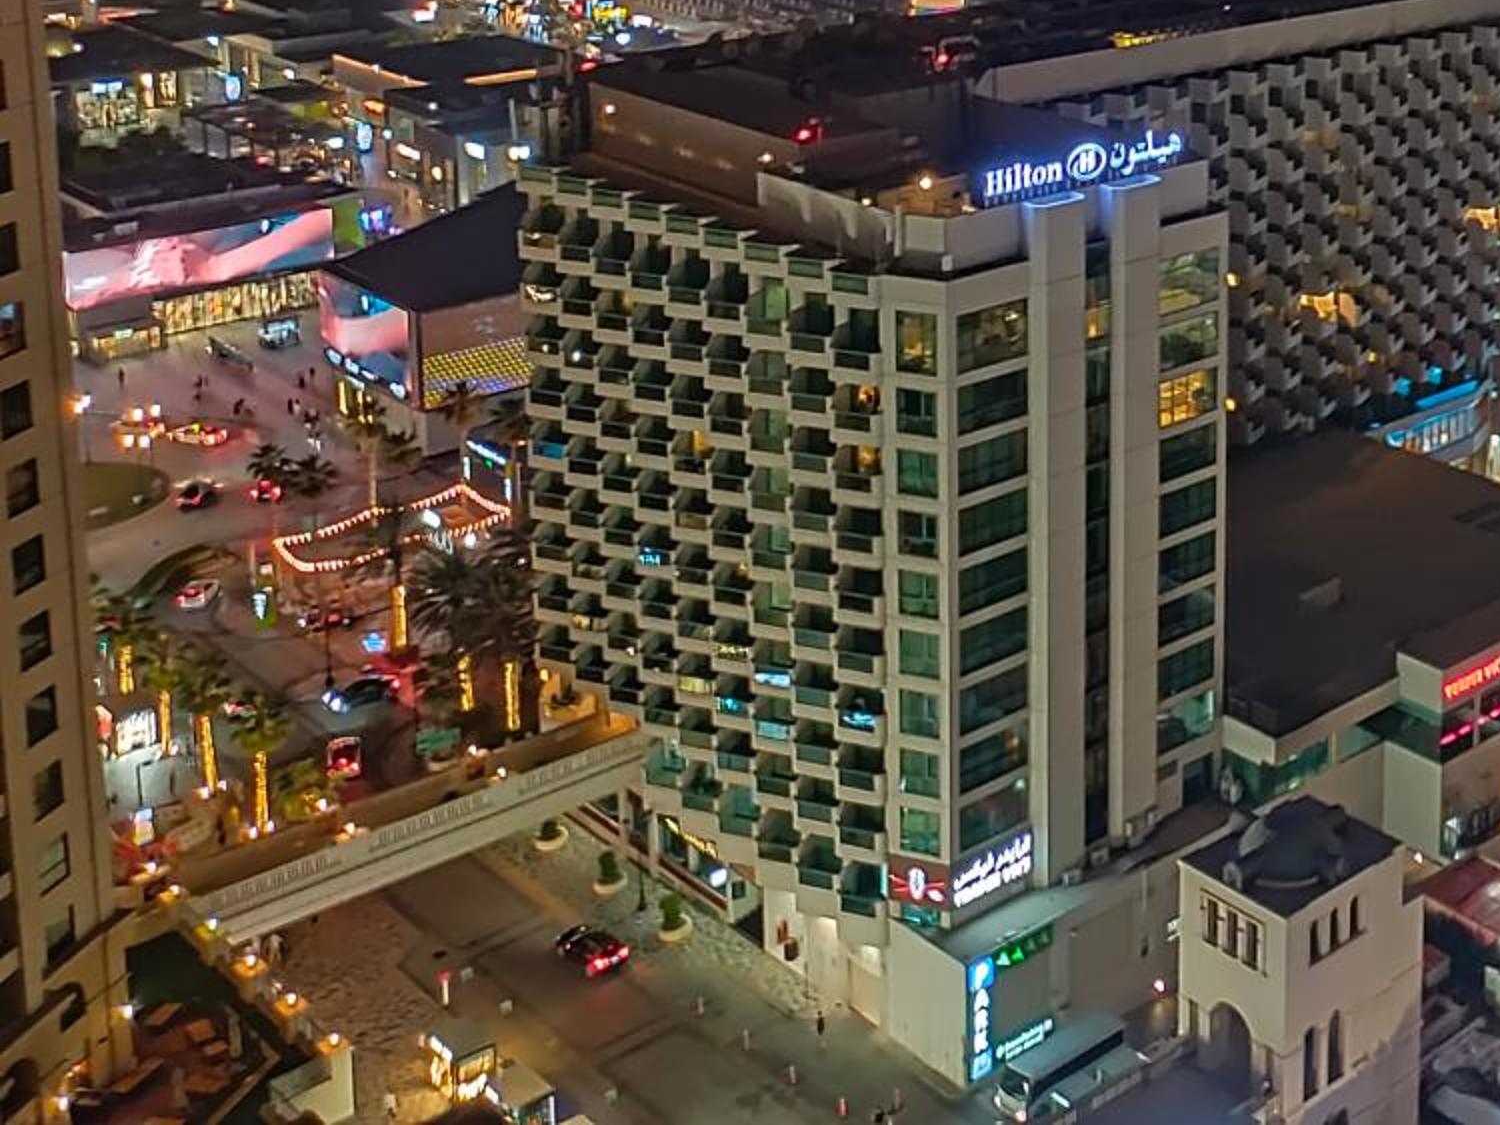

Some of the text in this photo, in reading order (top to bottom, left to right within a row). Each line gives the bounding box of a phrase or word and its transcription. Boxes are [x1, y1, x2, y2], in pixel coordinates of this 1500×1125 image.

[1109, 129, 1182, 175] هيلتون
[985, 161, 1063, 196] Hilton
[971, 959, 990, 1055] PARK
